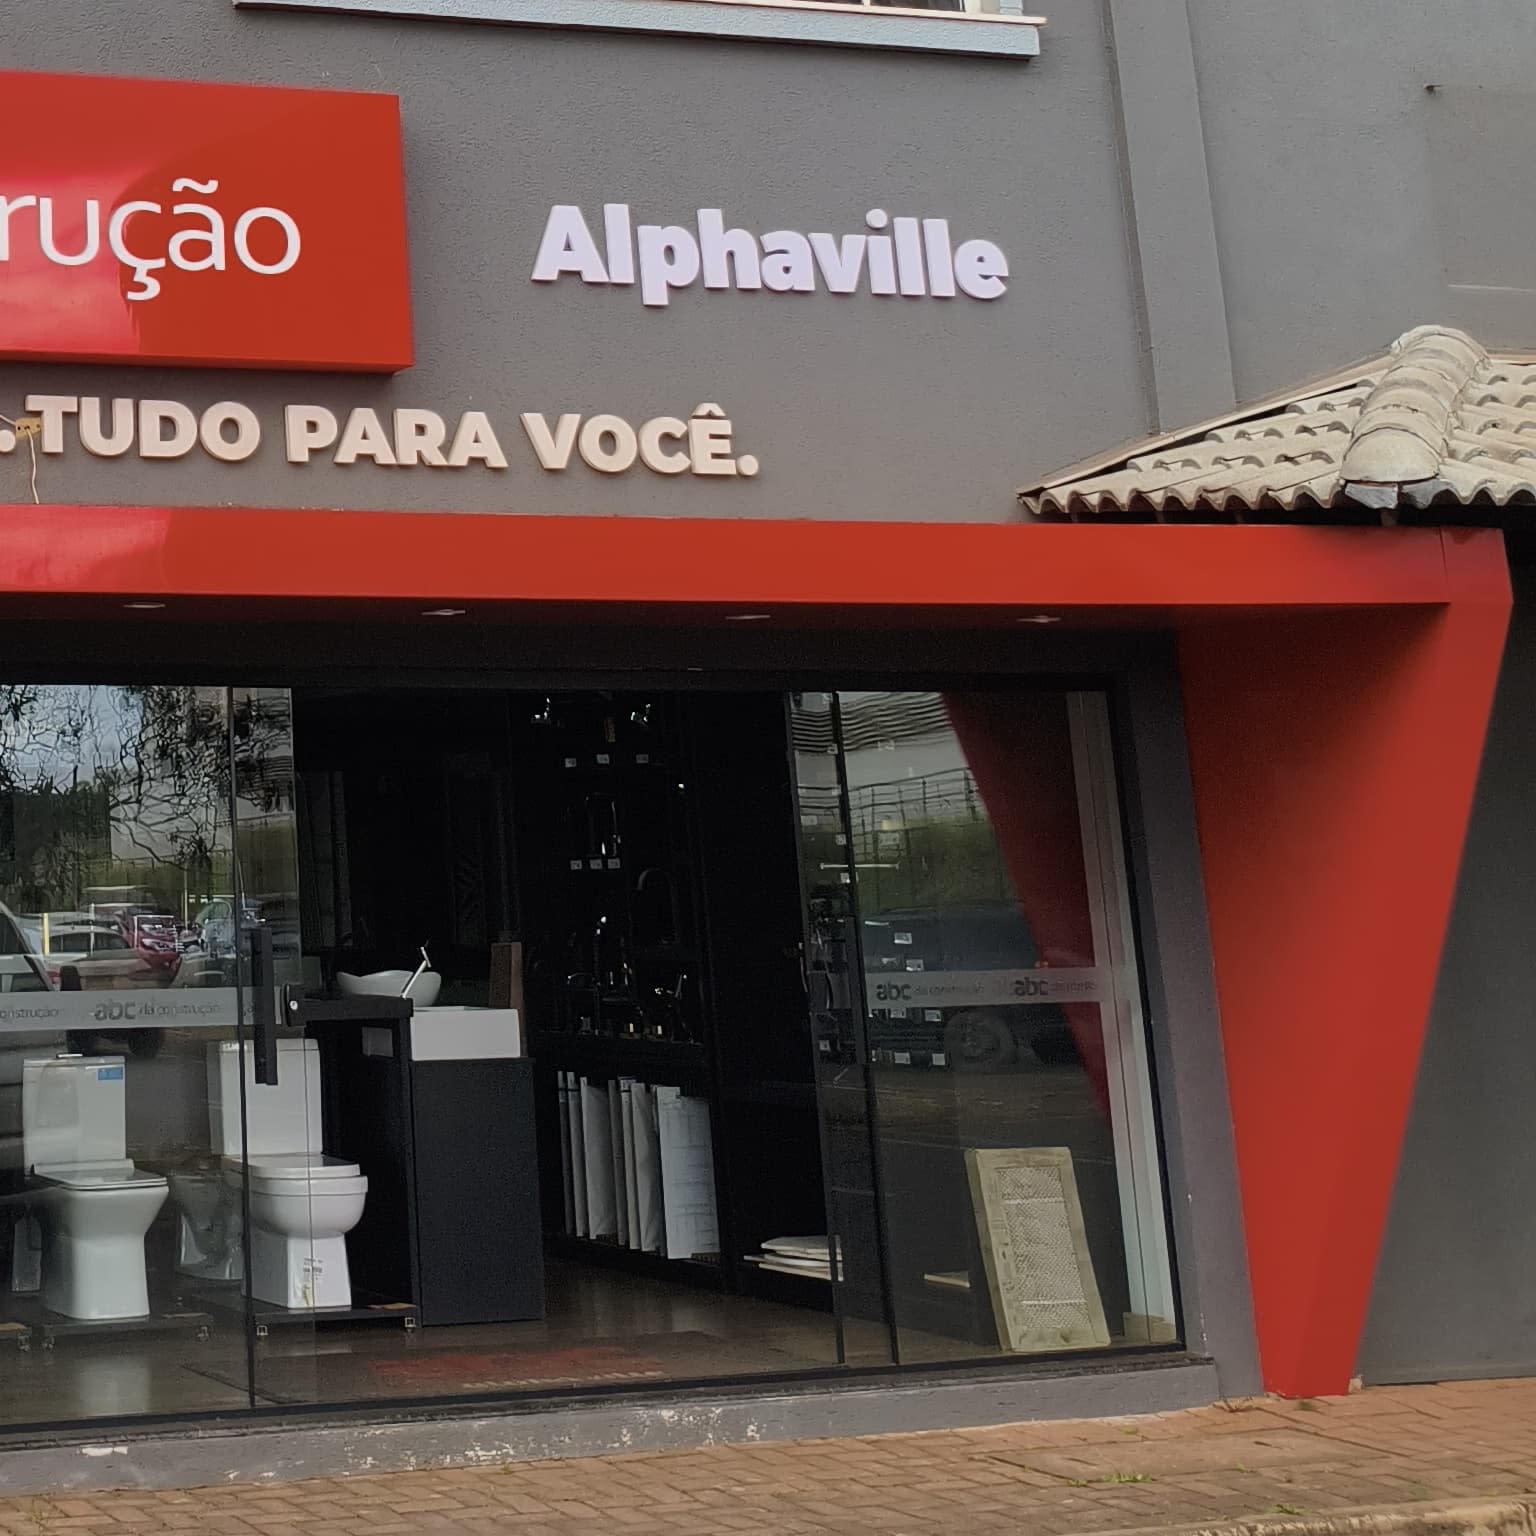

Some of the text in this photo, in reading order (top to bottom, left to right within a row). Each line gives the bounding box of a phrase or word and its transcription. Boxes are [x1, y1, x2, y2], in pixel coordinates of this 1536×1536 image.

[529, 201, 1010, 307] Alphaville
[24, 393, 262, 462] TUDO
[283, 403, 510, 469] PARA
[518, 401, 761, 477] VOCÊ.
[93, 997, 136, 1021] abc
